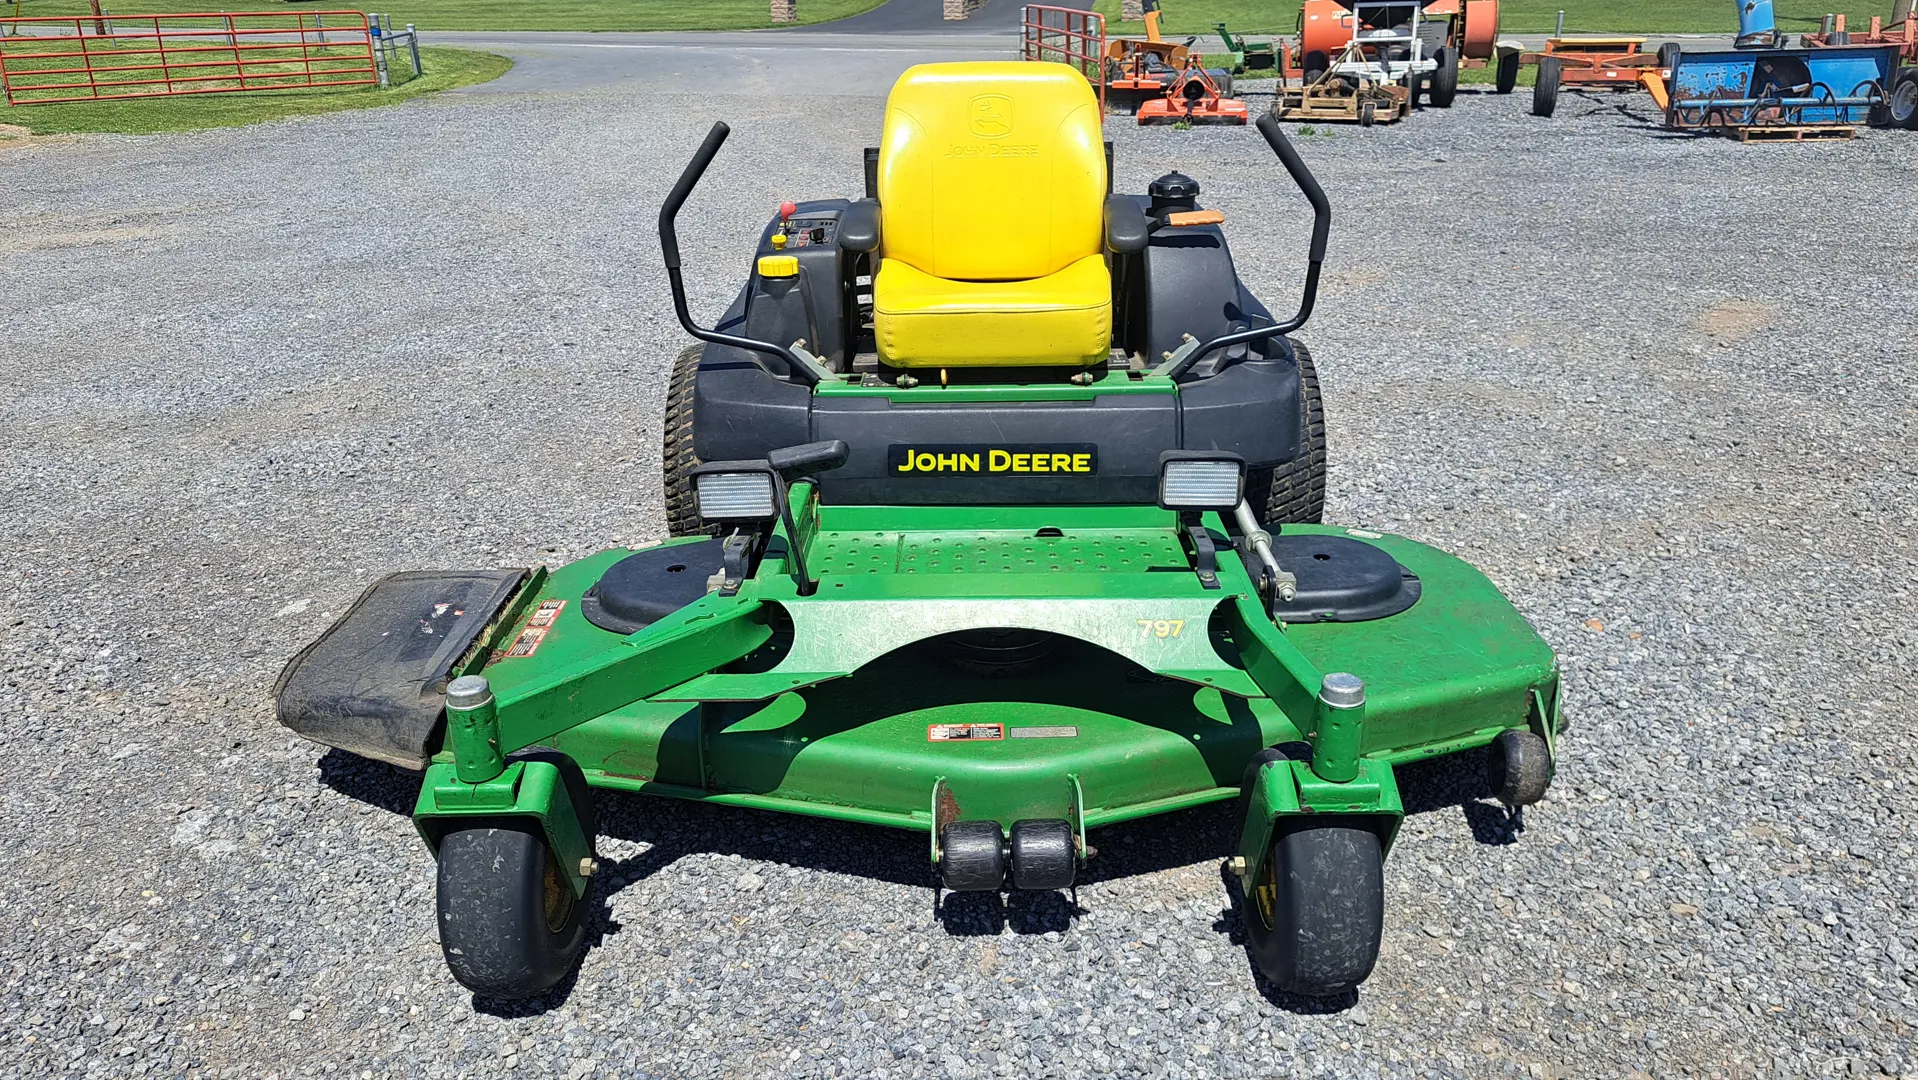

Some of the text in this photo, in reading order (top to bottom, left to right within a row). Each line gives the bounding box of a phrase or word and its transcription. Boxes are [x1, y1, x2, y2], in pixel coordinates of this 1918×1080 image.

[944, 143, 1040, 158] JOHN DEERE
[898, 449, 1091, 472] JOHN DEERE
[1137, 619, 1186, 639] 797
